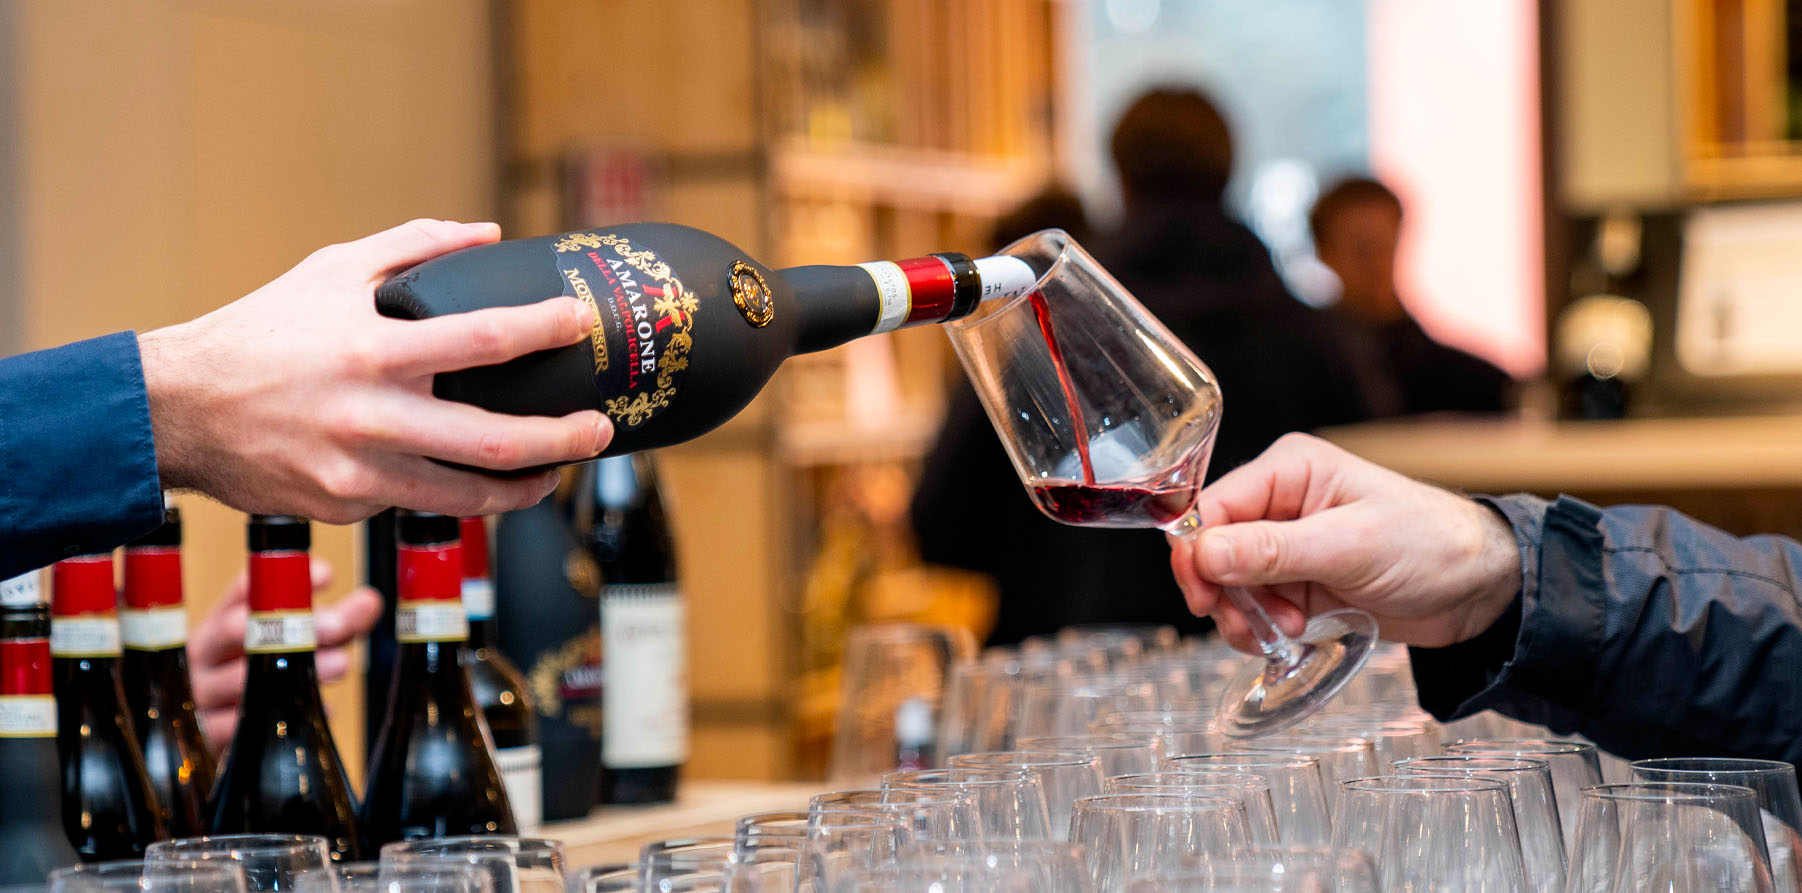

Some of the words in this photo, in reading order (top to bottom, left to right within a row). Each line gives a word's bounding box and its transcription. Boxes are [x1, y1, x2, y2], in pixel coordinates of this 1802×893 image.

[563, 268, 609, 375] MONESOR
[587, 251, 616, 286] DELLA
[613, 286, 640, 389] VALPOLICELLA
[606, 258, 655, 374] AMARONE
